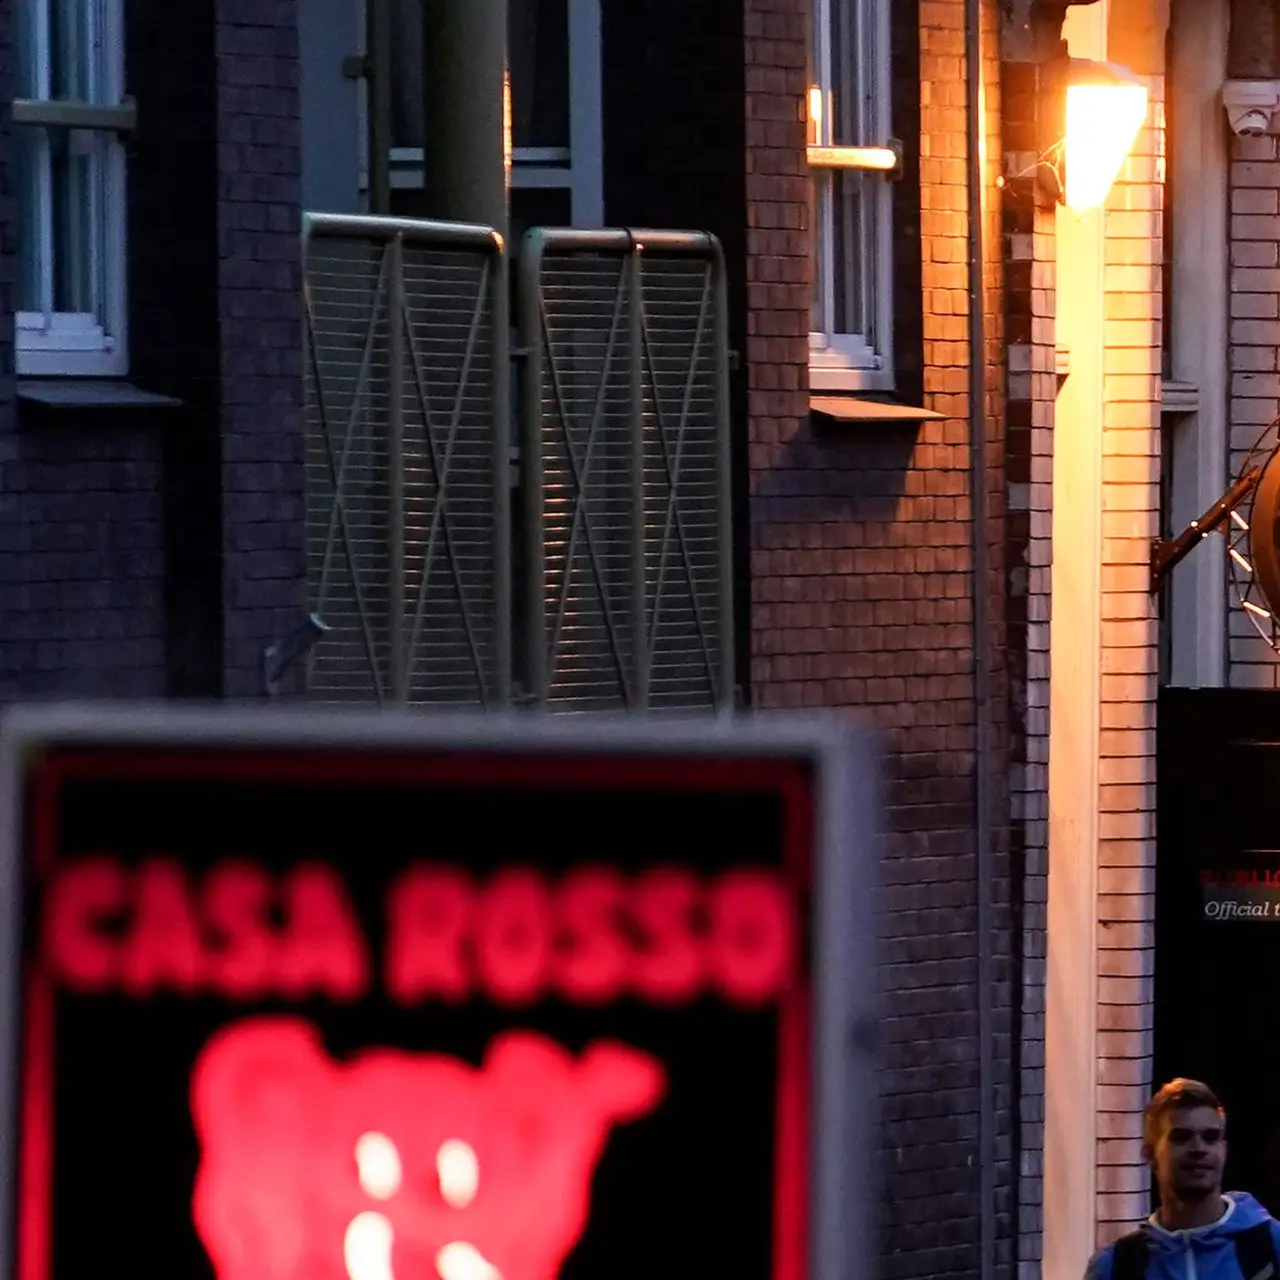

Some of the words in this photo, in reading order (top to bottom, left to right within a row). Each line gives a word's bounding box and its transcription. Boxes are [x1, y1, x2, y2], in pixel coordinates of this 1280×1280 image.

[46, 856, 370, 1000] CASA
[386, 862, 794, 1006] ROSSO
[1204, 901, 1269, 920] Official
